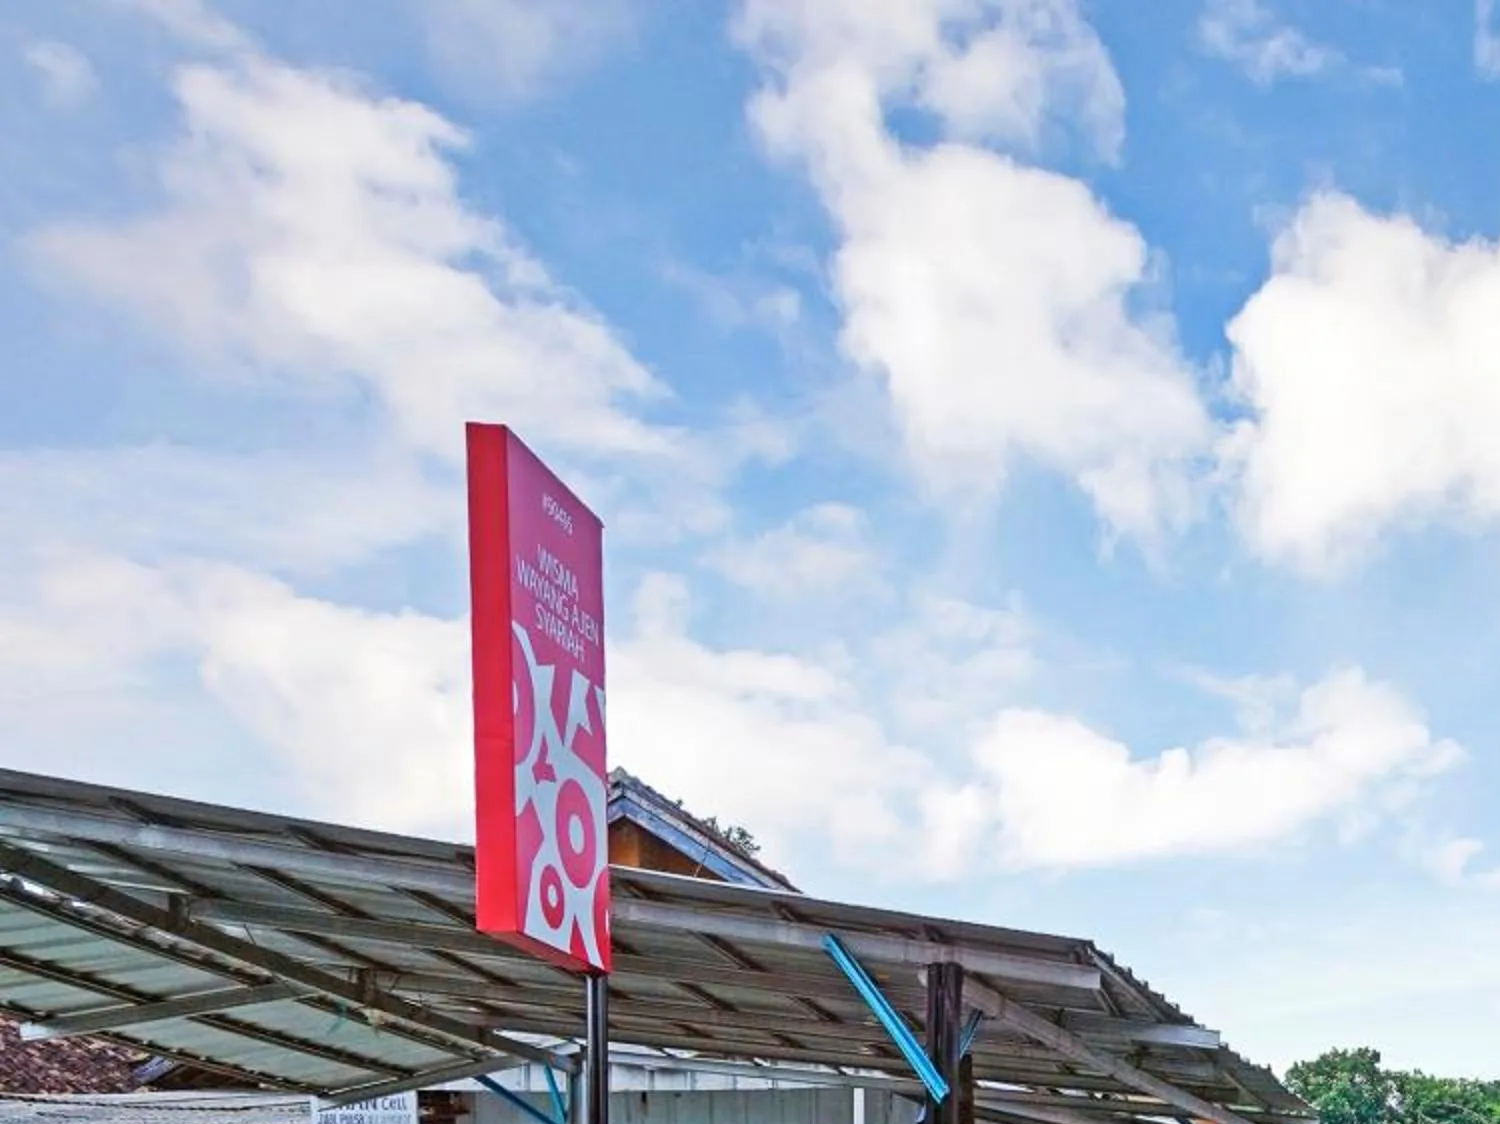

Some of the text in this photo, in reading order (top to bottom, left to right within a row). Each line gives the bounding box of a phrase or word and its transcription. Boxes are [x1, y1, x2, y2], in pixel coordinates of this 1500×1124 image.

[515, 553, 599, 646] WAYANG AJEN
[537, 543, 579, 602] WISMA
[535, 602, 585, 664] SYARIAH
